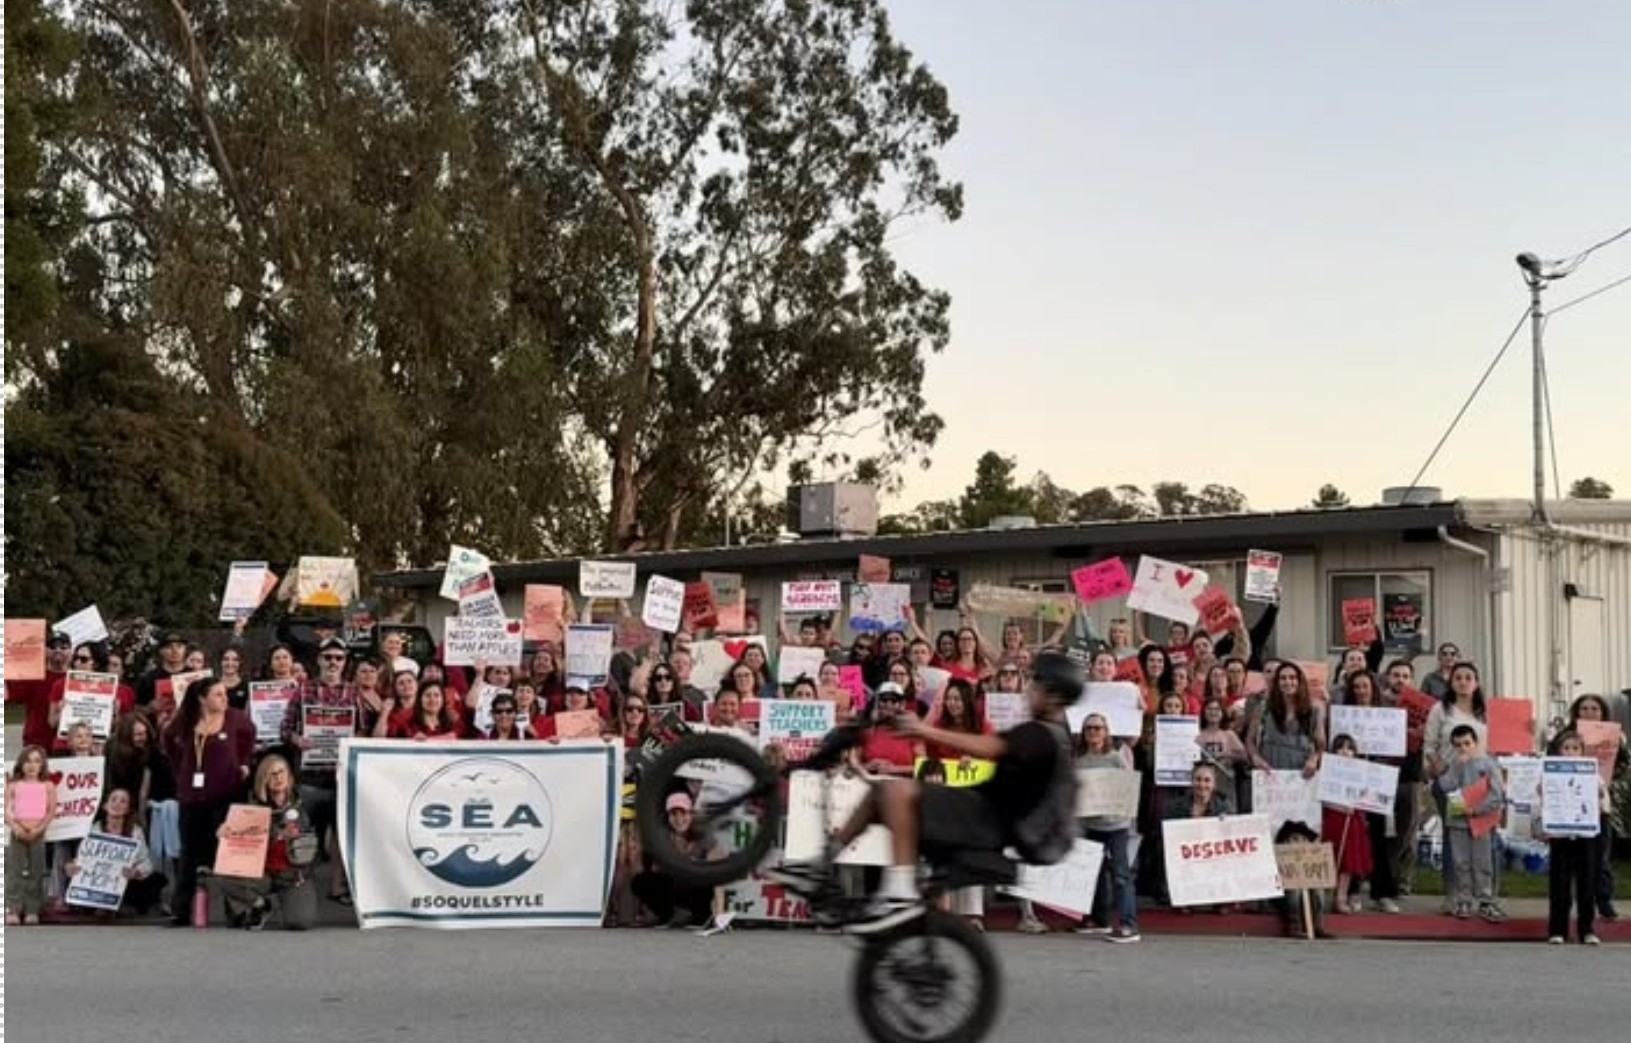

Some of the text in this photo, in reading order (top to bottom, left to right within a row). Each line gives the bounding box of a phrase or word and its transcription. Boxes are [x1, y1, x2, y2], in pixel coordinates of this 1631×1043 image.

[768, 719, 828, 731] TEACHERS
[66, 772, 99, 790] OUR
[55, 797, 97, 818] CHERS
[420, 803, 544, 829] SEA
[1181, 837, 1258, 860] DESERVE
[410, 892, 544, 909] #SOQUELSTYLE
